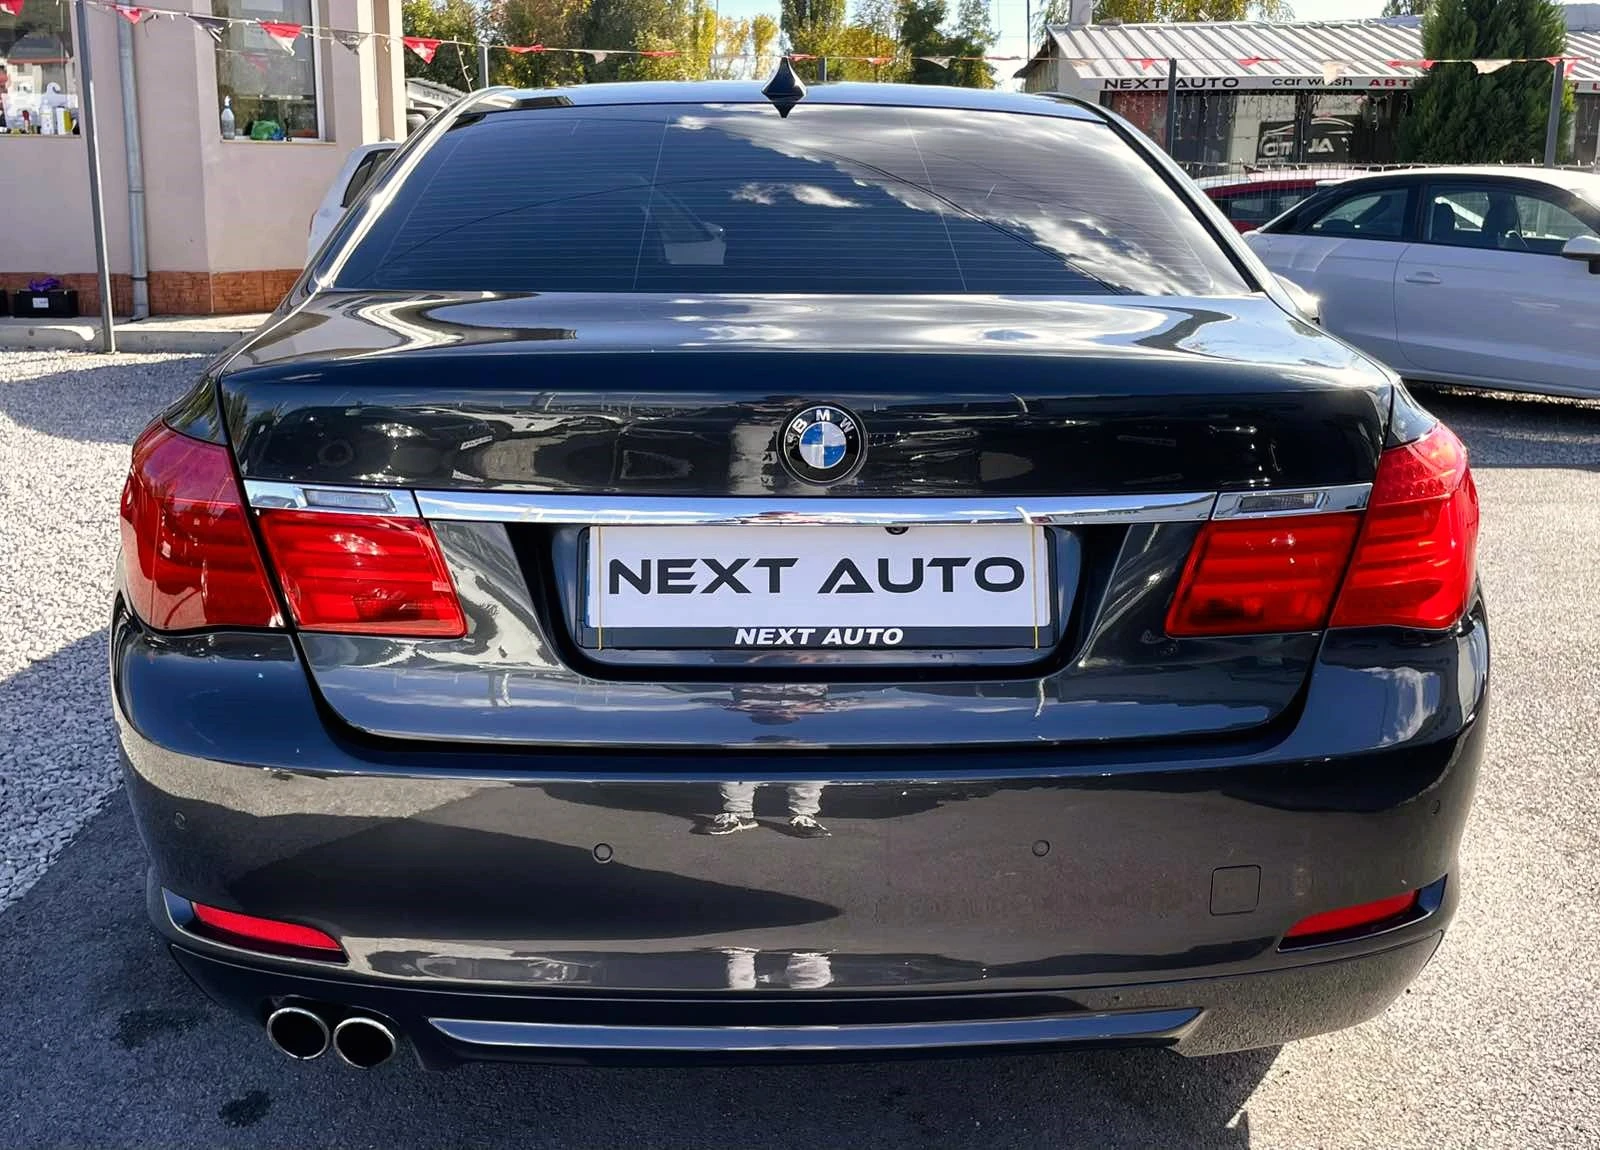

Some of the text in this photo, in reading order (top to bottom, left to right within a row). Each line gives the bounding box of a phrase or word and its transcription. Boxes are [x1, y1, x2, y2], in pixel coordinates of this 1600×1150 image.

[1104, 77, 1239, 89] NEXT AUTO
[1272, 78, 1302, 86] car
[1368, 78, 1416, 87] АВТ
[792, 409, 854, 433] BMW
[608, 557, 1025, 594] NEXT AUTO
[734, 628, 904, 645] NEXT AUTO
